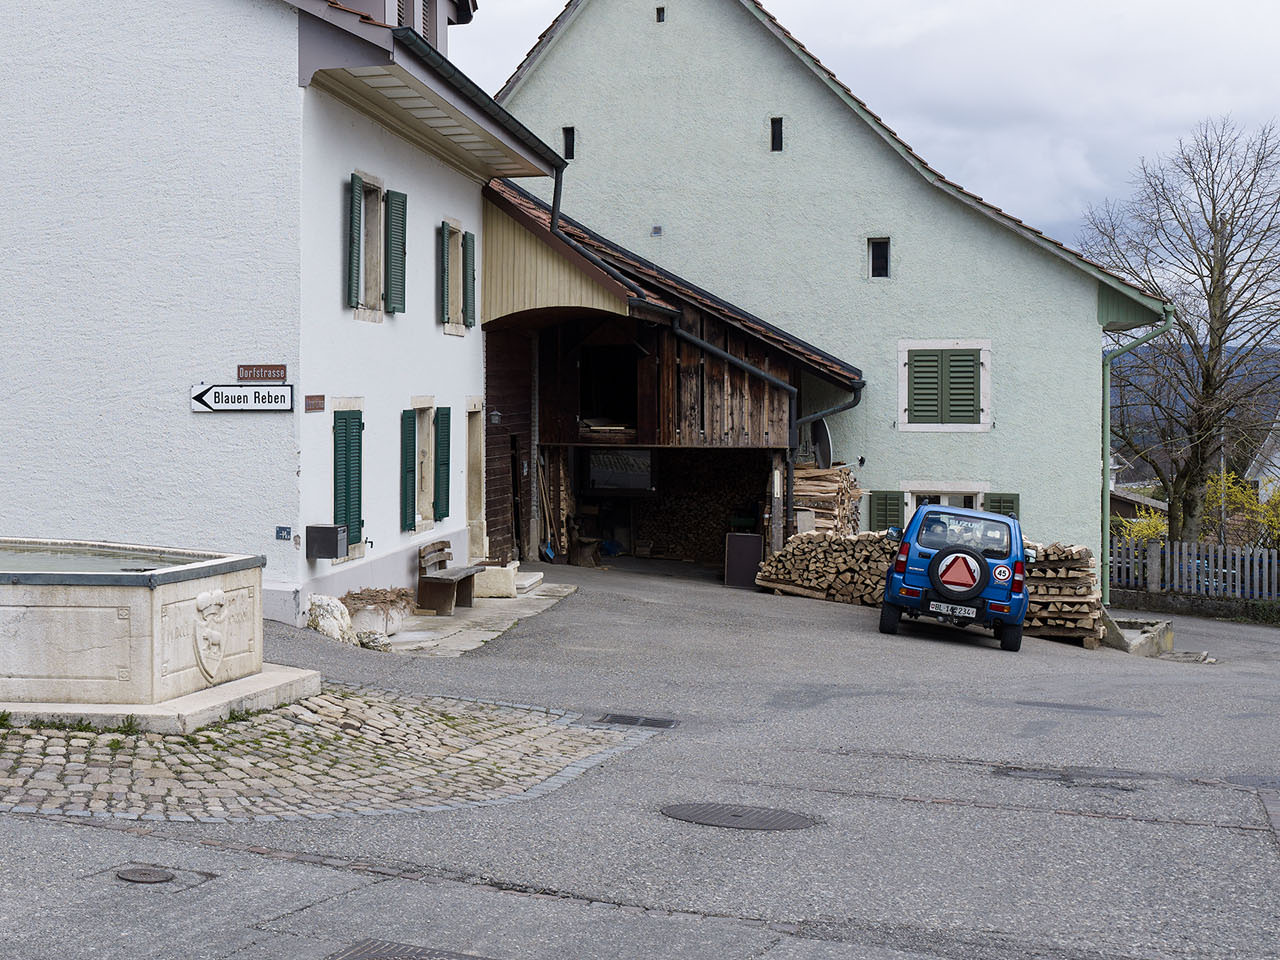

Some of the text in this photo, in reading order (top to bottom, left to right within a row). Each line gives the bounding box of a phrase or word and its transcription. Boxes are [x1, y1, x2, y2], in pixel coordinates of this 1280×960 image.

[240, 368, 285, 378] Dorfstrasse
[214, 391, 286, 404] Blauen Reben
[997, 569, 1007, 577] 45
